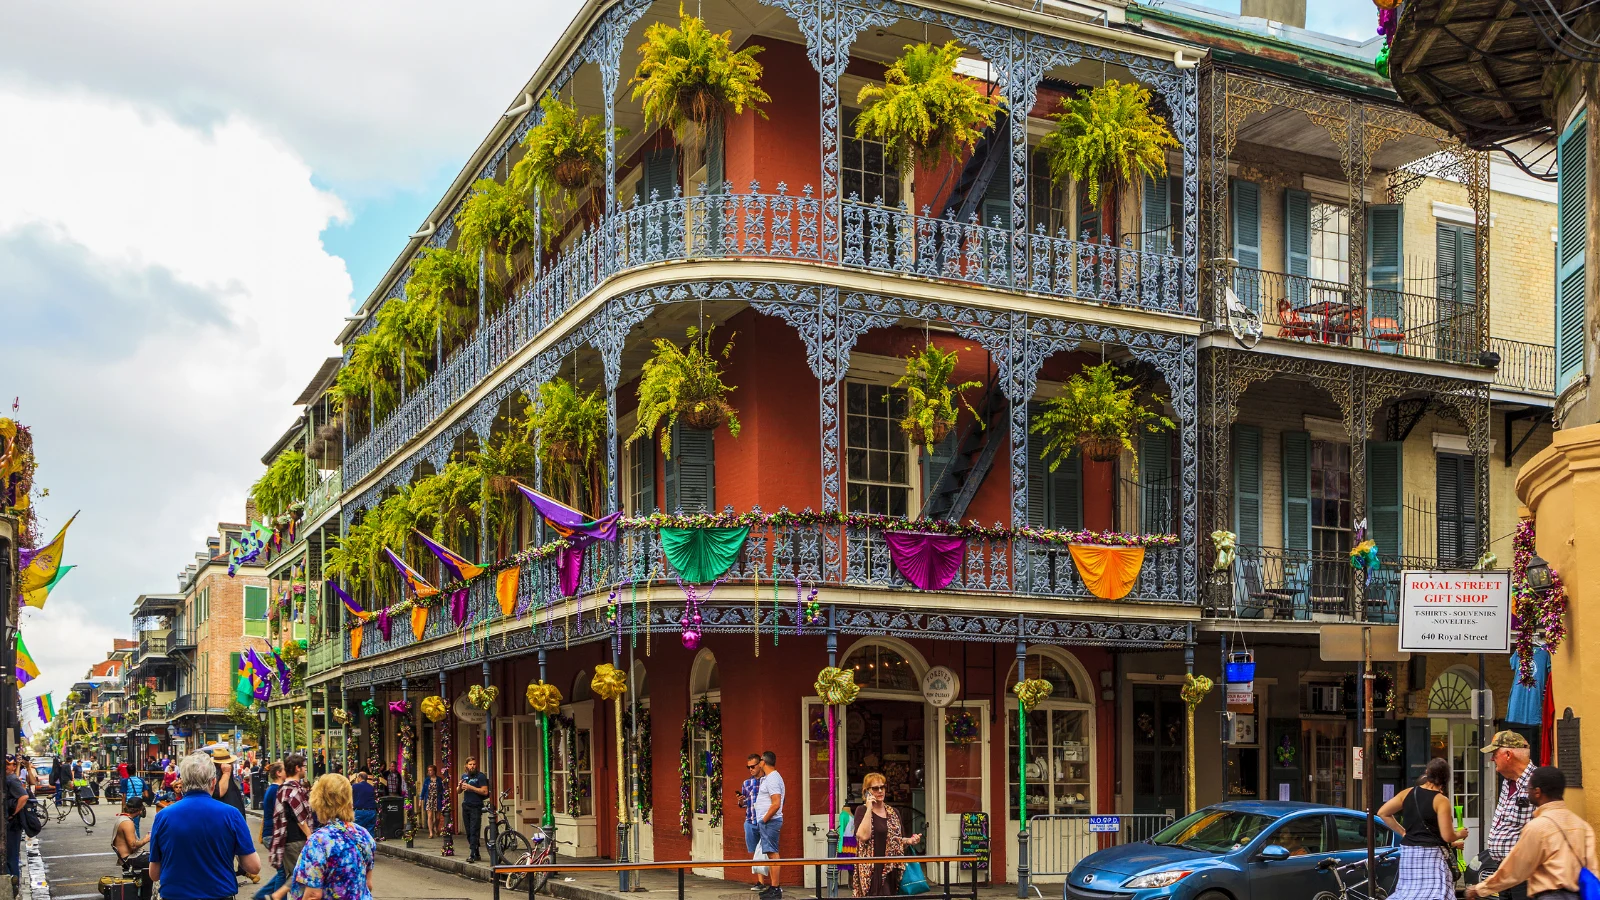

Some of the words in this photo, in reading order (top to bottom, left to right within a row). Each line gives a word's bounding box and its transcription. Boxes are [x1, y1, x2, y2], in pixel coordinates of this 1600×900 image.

[1411, 581, 1453, 590] ROYAL
[1454, 581, 1502, 590] STREET
[1424, 594, 1453, 603] GIFT
[1455, 594, 1489, 603] SHOP
[1438, 633, 1462, 642] Royal
[1463, 633, 1488, 641] Street
[926, 670, 951, 684] FOREVER
